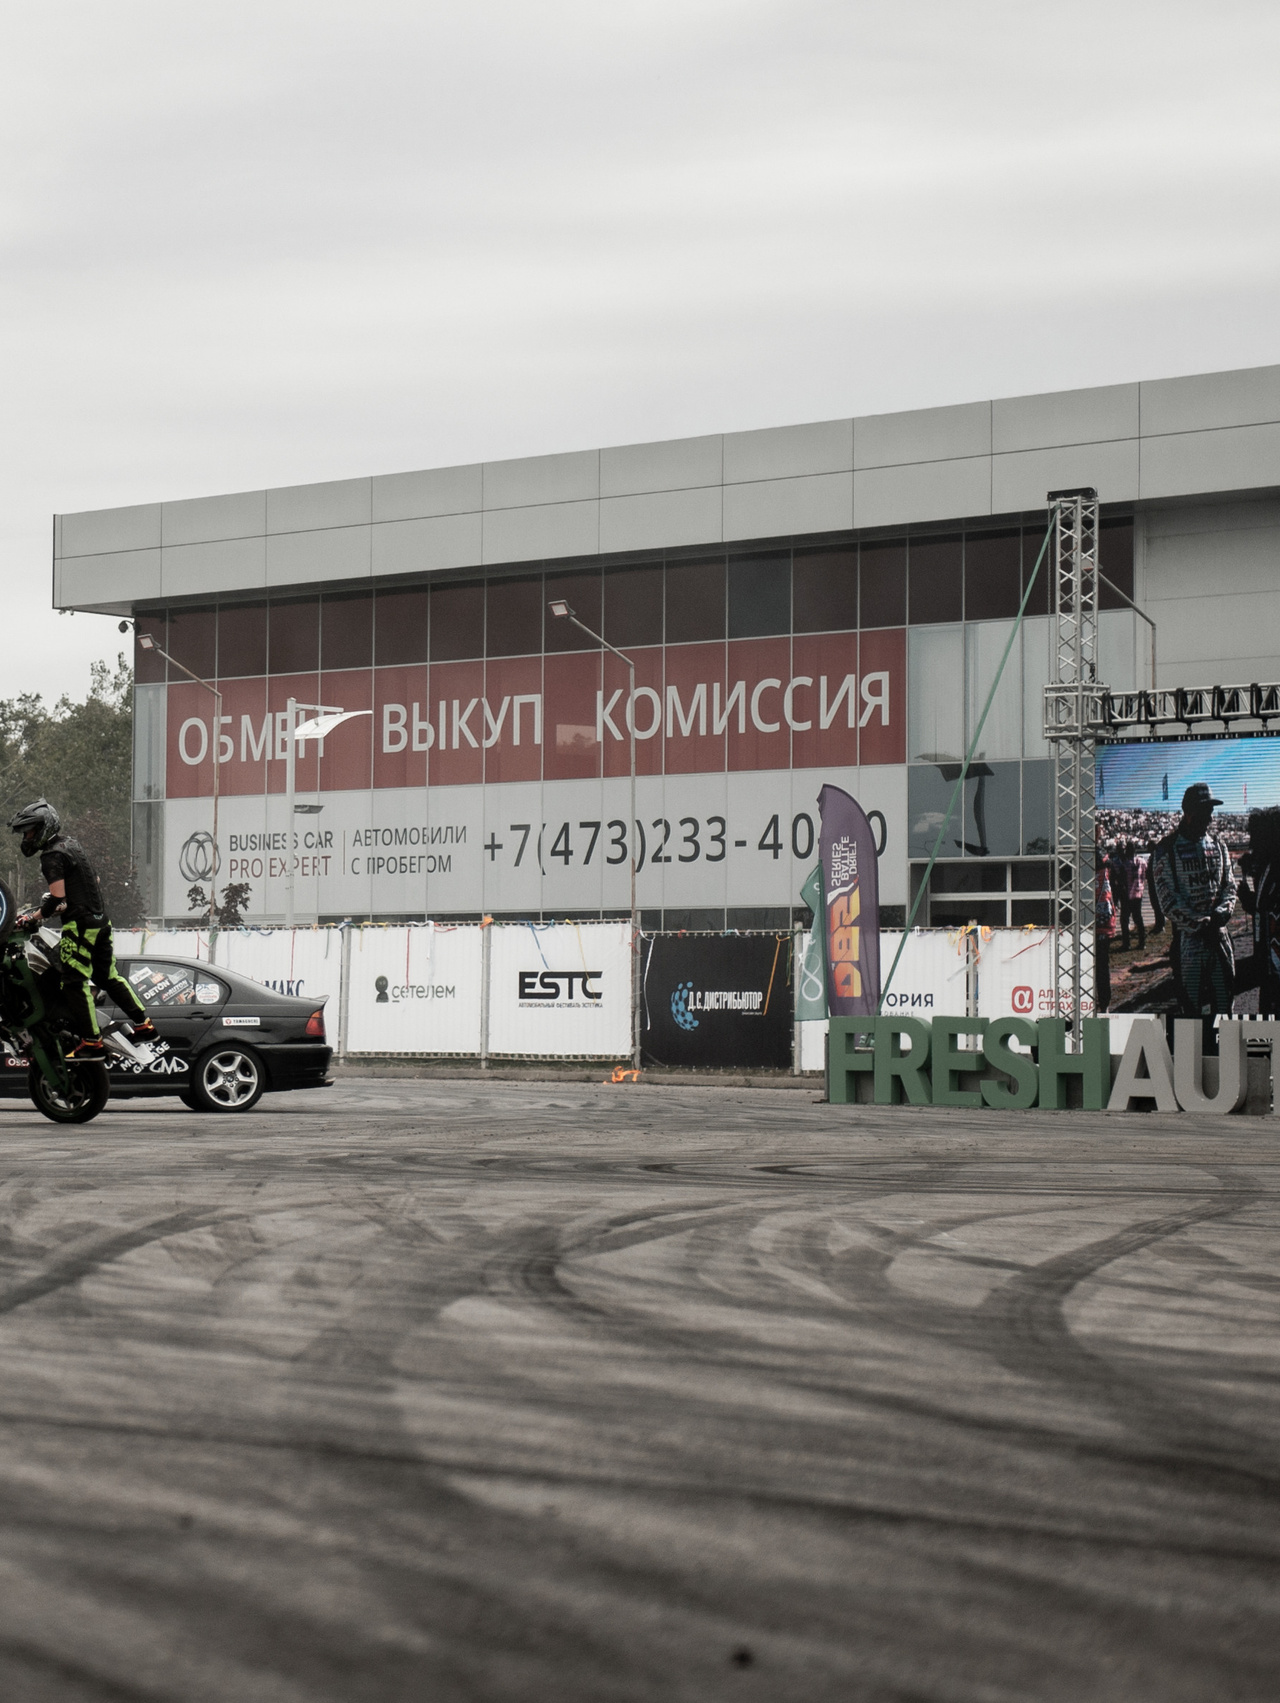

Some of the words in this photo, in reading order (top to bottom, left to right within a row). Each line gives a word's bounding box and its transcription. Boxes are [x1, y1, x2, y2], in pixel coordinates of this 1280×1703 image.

[383, 694, 542, 753] ВЫКУП
[596, 671, 890, 742] КОМИССИЯ
[229, 832, 298, 851] BUSINESS
[304, 831, 333, 849] CAR
[352, 825, 468, 847] АВТОМОБИЛИ
[229, 858, 263, 878] PRO
[270, 855, 332, 877] EXPERT
[367, 854, 452, 875] ПРОБЕГОМ
[519, 971, 603, 999] ESTC
[886, 993, 933, 1007] ОРИЯ
